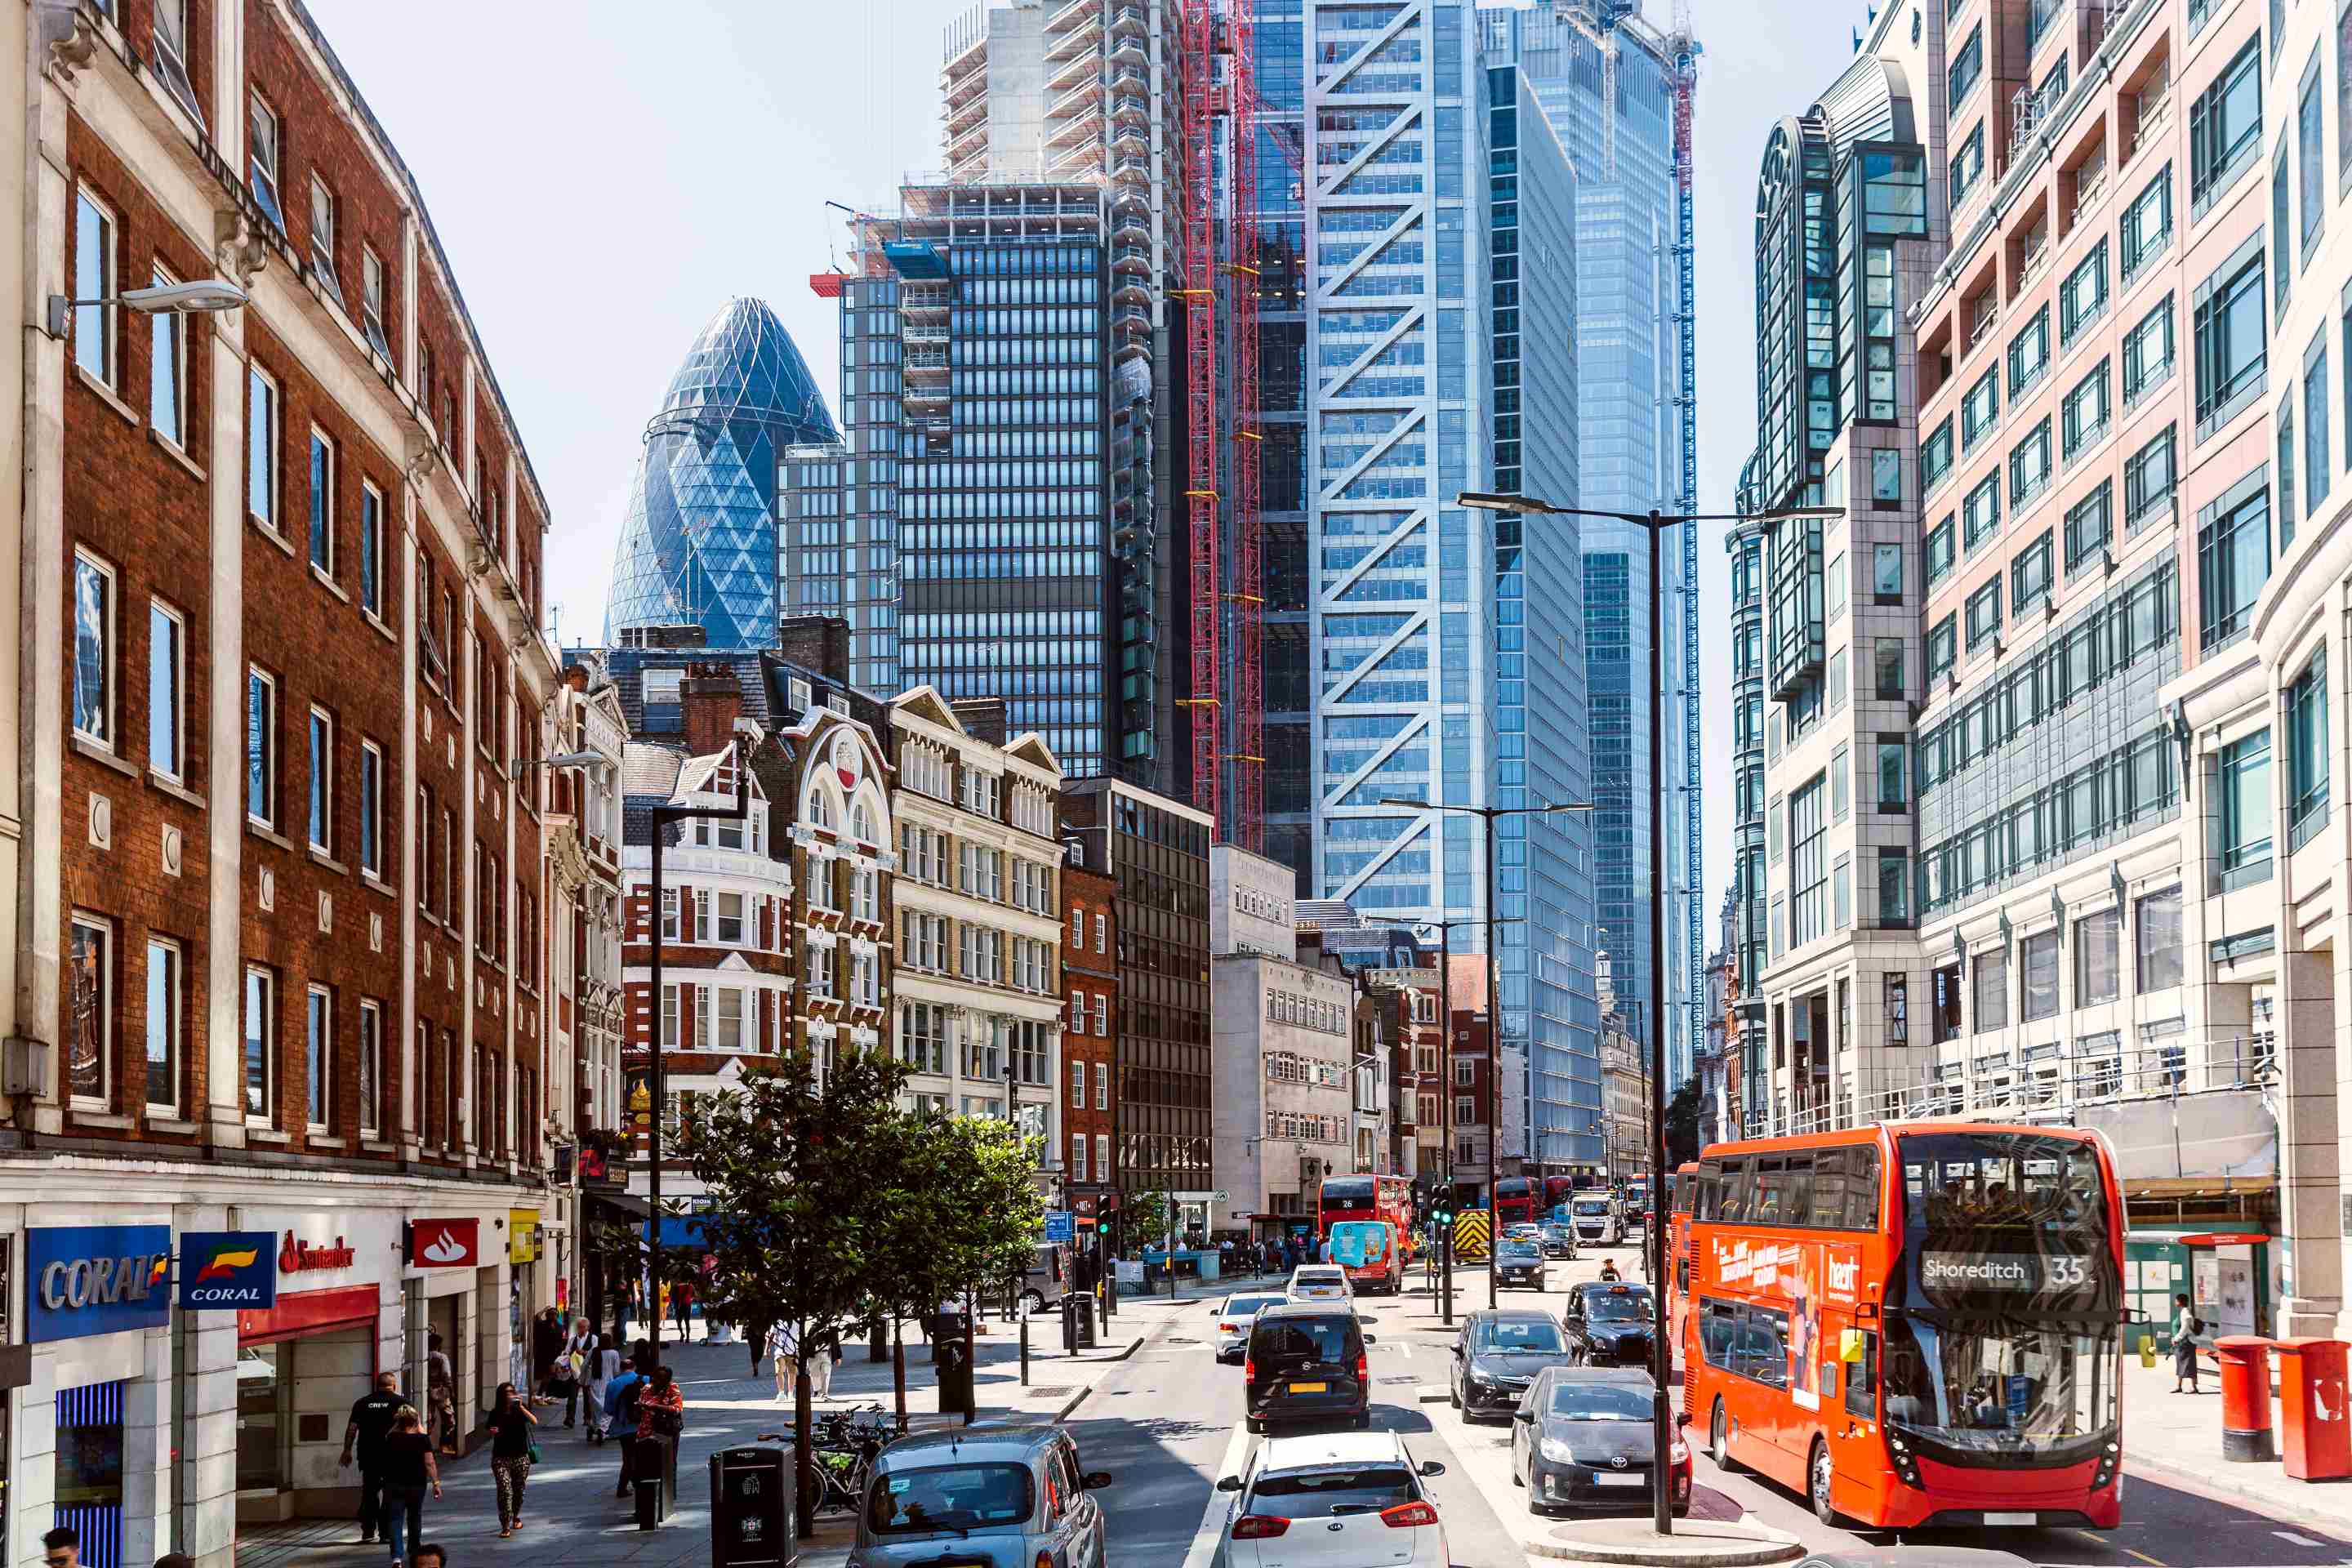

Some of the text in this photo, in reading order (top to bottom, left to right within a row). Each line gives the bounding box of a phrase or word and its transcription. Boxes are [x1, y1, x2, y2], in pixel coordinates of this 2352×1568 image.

[298, 1235, 355, 1272] Santander
[1925, 1259, 2025, 1279] Shoreditch
[40, 1254, 153, 1311] CORAL
[1829, 1254, 1860, 1291] heart
[2051, 1257, 2085, 1285] 35
[191, 1287, 261, 1302] CORAL
